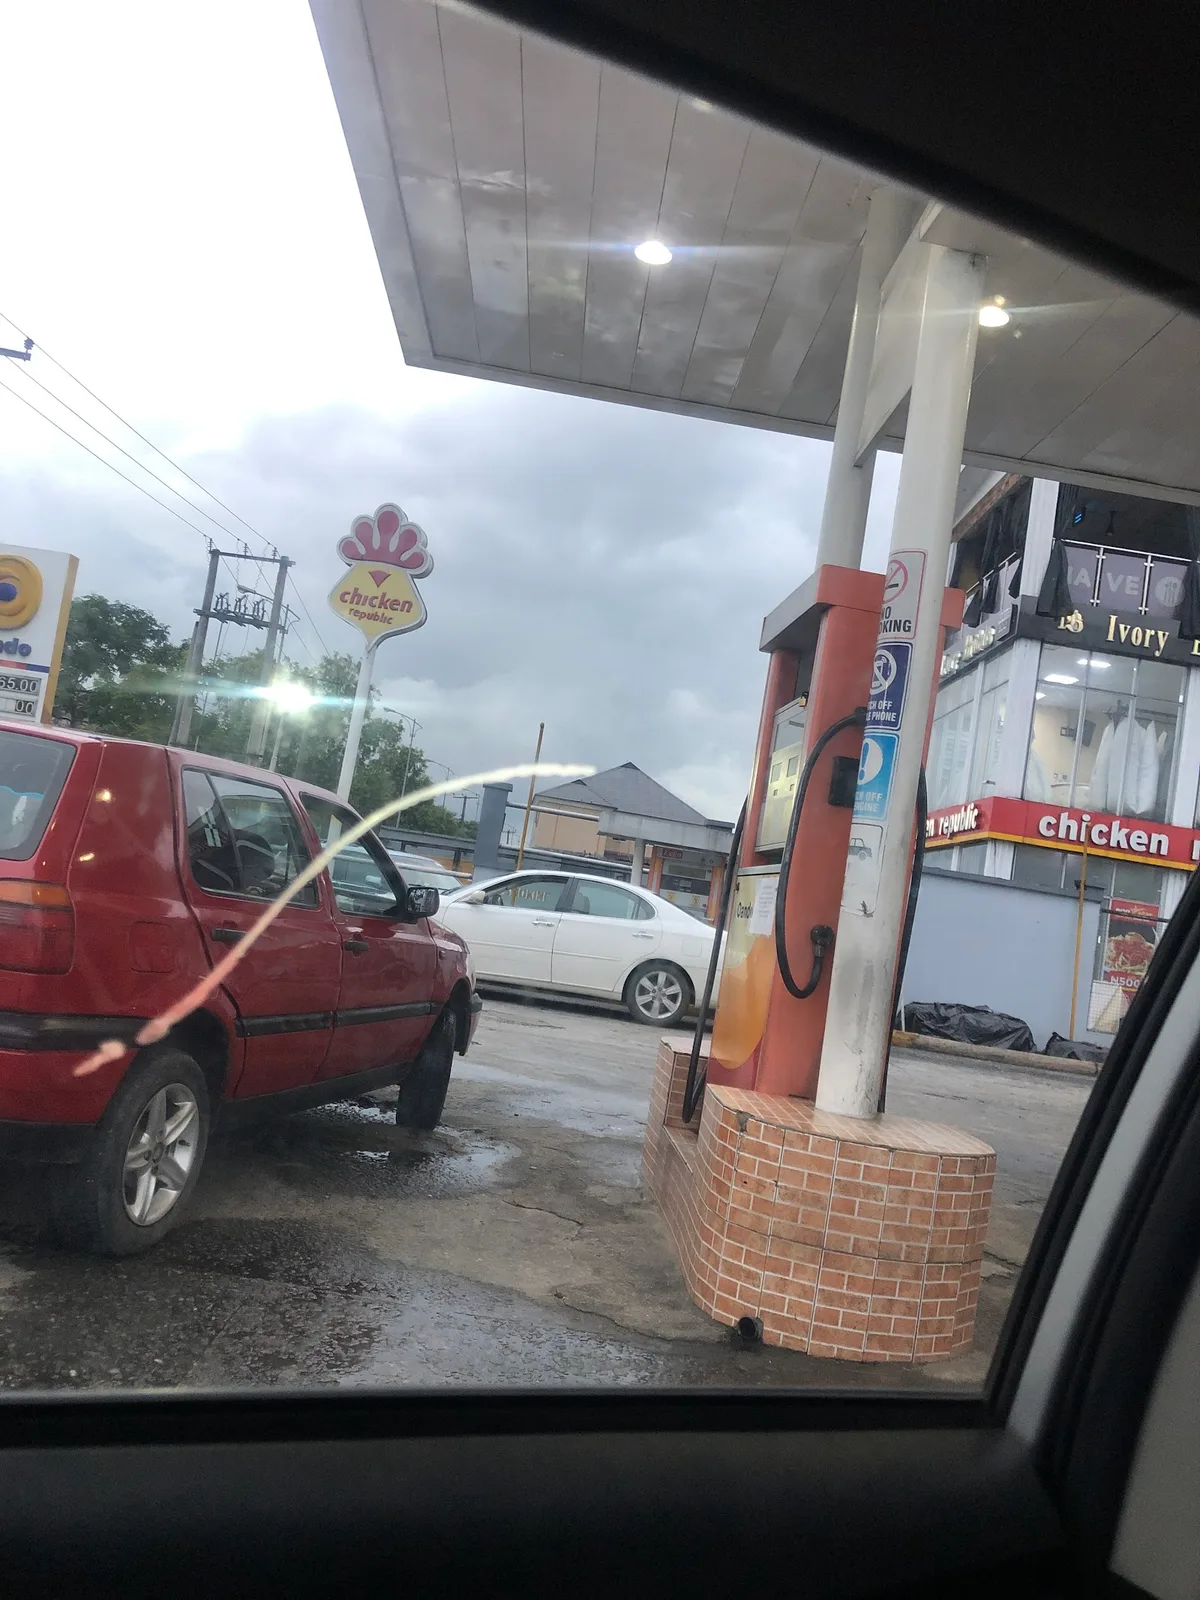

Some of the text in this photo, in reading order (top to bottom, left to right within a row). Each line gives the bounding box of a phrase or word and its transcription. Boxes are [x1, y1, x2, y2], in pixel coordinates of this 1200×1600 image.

[339, 587, 413, 613] chicken
[348, 607, 393, 625] republic
[1106, 614, 1170, 657] Ivory
[871, 711, 897, 722] PHONE
[877, 700, 893, 711] OFF
[939, 802, 979, 839] republic
[1038, 811, 1169, 856] chicken
[736, 901, 754, 919] Oand
